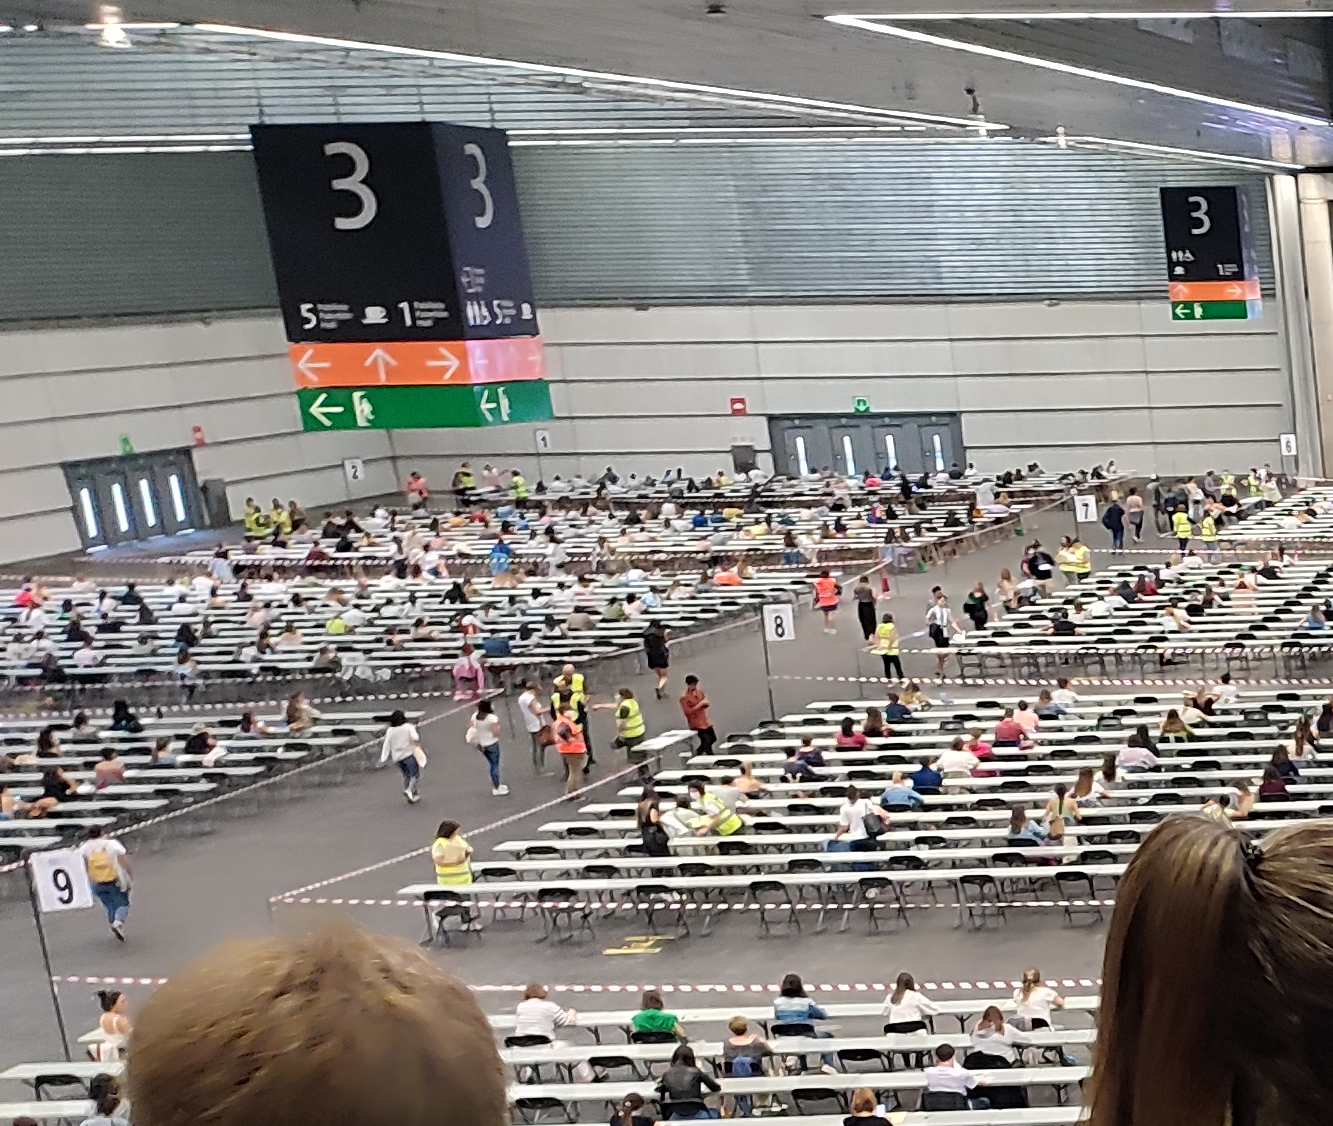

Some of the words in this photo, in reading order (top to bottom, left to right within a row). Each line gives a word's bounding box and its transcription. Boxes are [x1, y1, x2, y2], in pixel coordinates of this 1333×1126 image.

[323, 142, 378, 230] 3
[463, 143, 494, 228] 3
[1187, 196, 1211, 235] 3
[300, 303, 317, 330] 5
[397, 301, 413, 327] 1
[540, 436, 548, 448] 1
[351, 464, 359, 480] 2
[1082, 502, 1090, 520] 7
[774, 614, 785, 638] 8
[52, 868, 74, 905] 9
